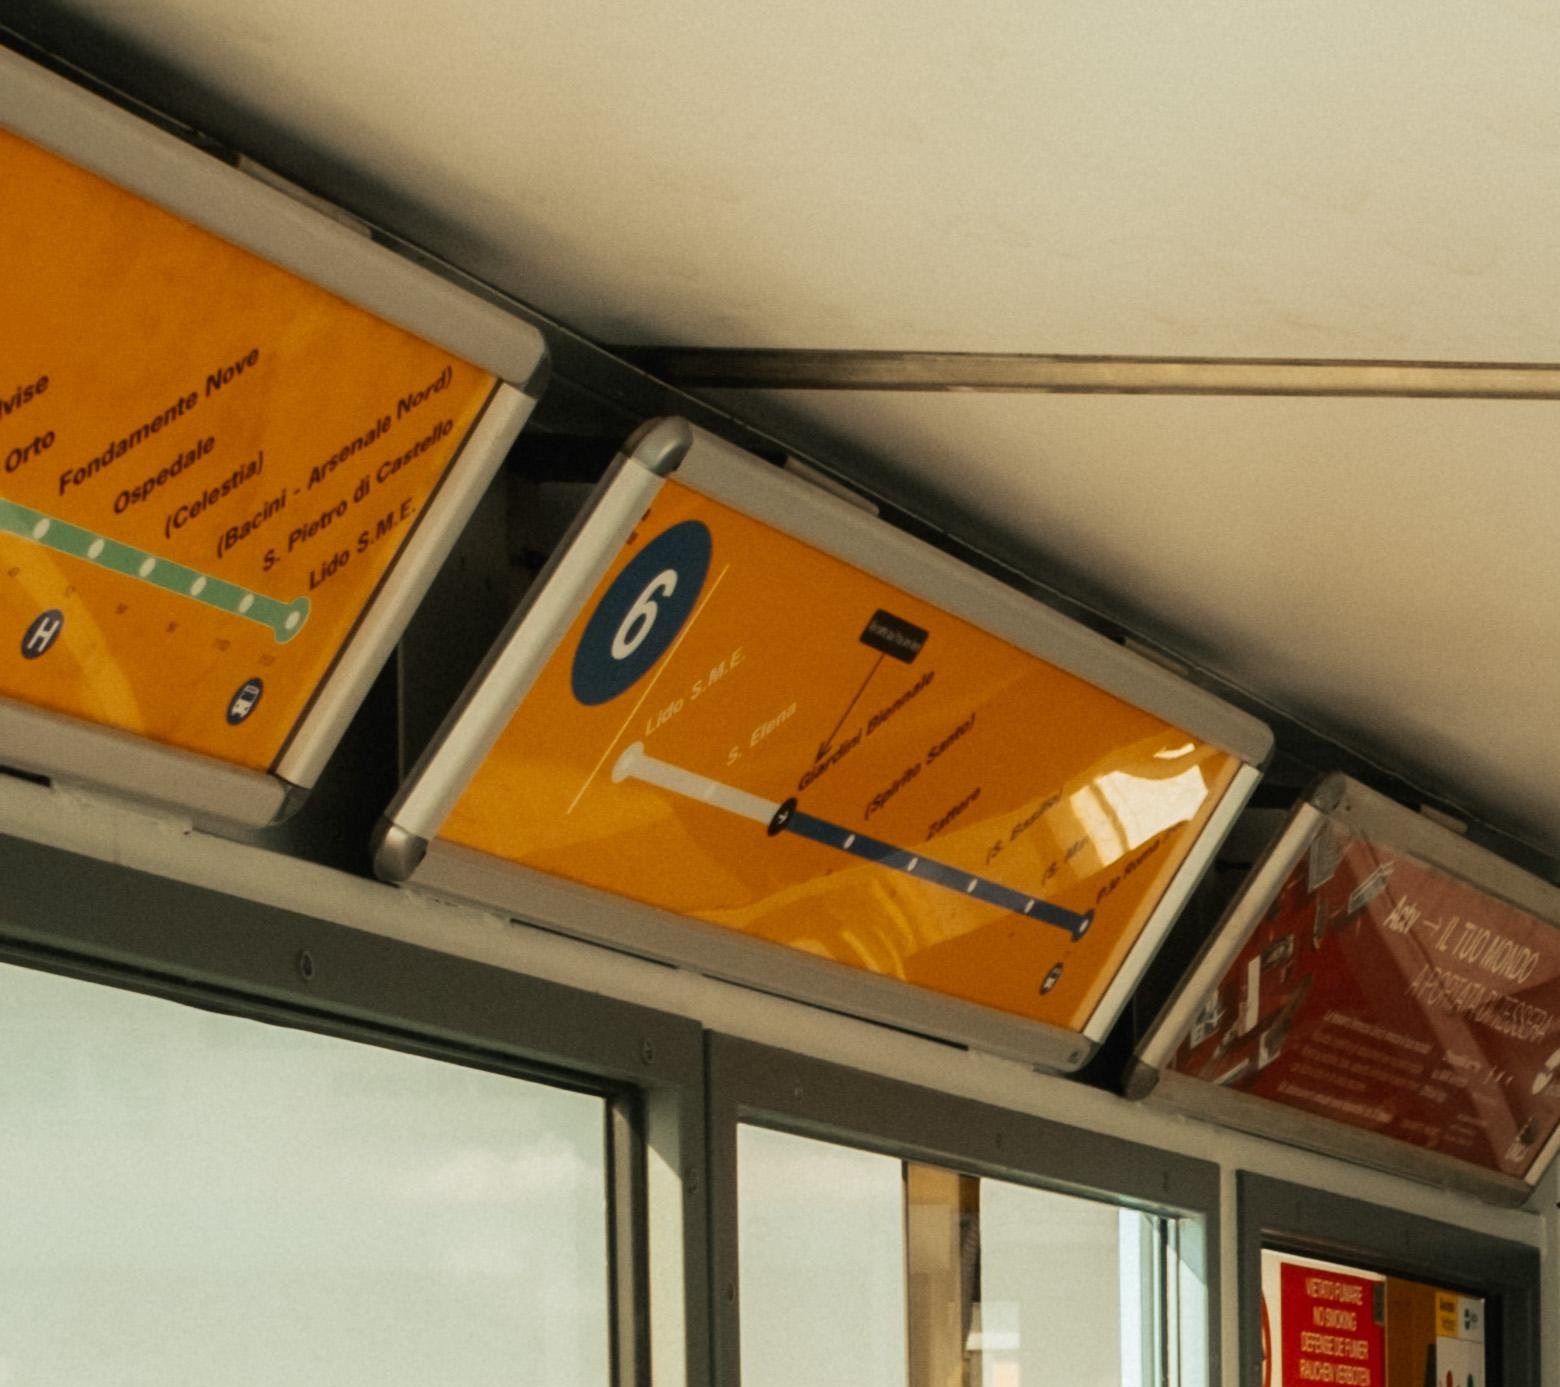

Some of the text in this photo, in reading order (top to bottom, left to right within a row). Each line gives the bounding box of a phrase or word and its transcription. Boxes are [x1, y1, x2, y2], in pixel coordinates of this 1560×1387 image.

[5, 430, 55, 473] Orto
[59, 348, 260, 496] Fondamente Nove
[217, 489, 287, 558] (Bacini
[307, 413, 392, 489] Arsenale
[396, 365, 453, 419] Nord)
[113, 434, 216, 515] Ospedale
[165, 450, 265, 538] (Celestia)
[262, 417, 454, 573] S. Pietro di Castello
[309, 497, 417, 591] Lido S.M.E.
[611, 569, 679, 660] 6
[645, 698, 685, 737] Lido
[754, 701, 798, 749] Elena
[798, 670, 936, 792] Giardini Biennale
[865, 711, 977, 822] (Spirito Santo)
[926, 786, 982, 842] Zattere
[1452, 921, 1492, 964] TUO
[1477, 934, 1541, 985] MONDO
